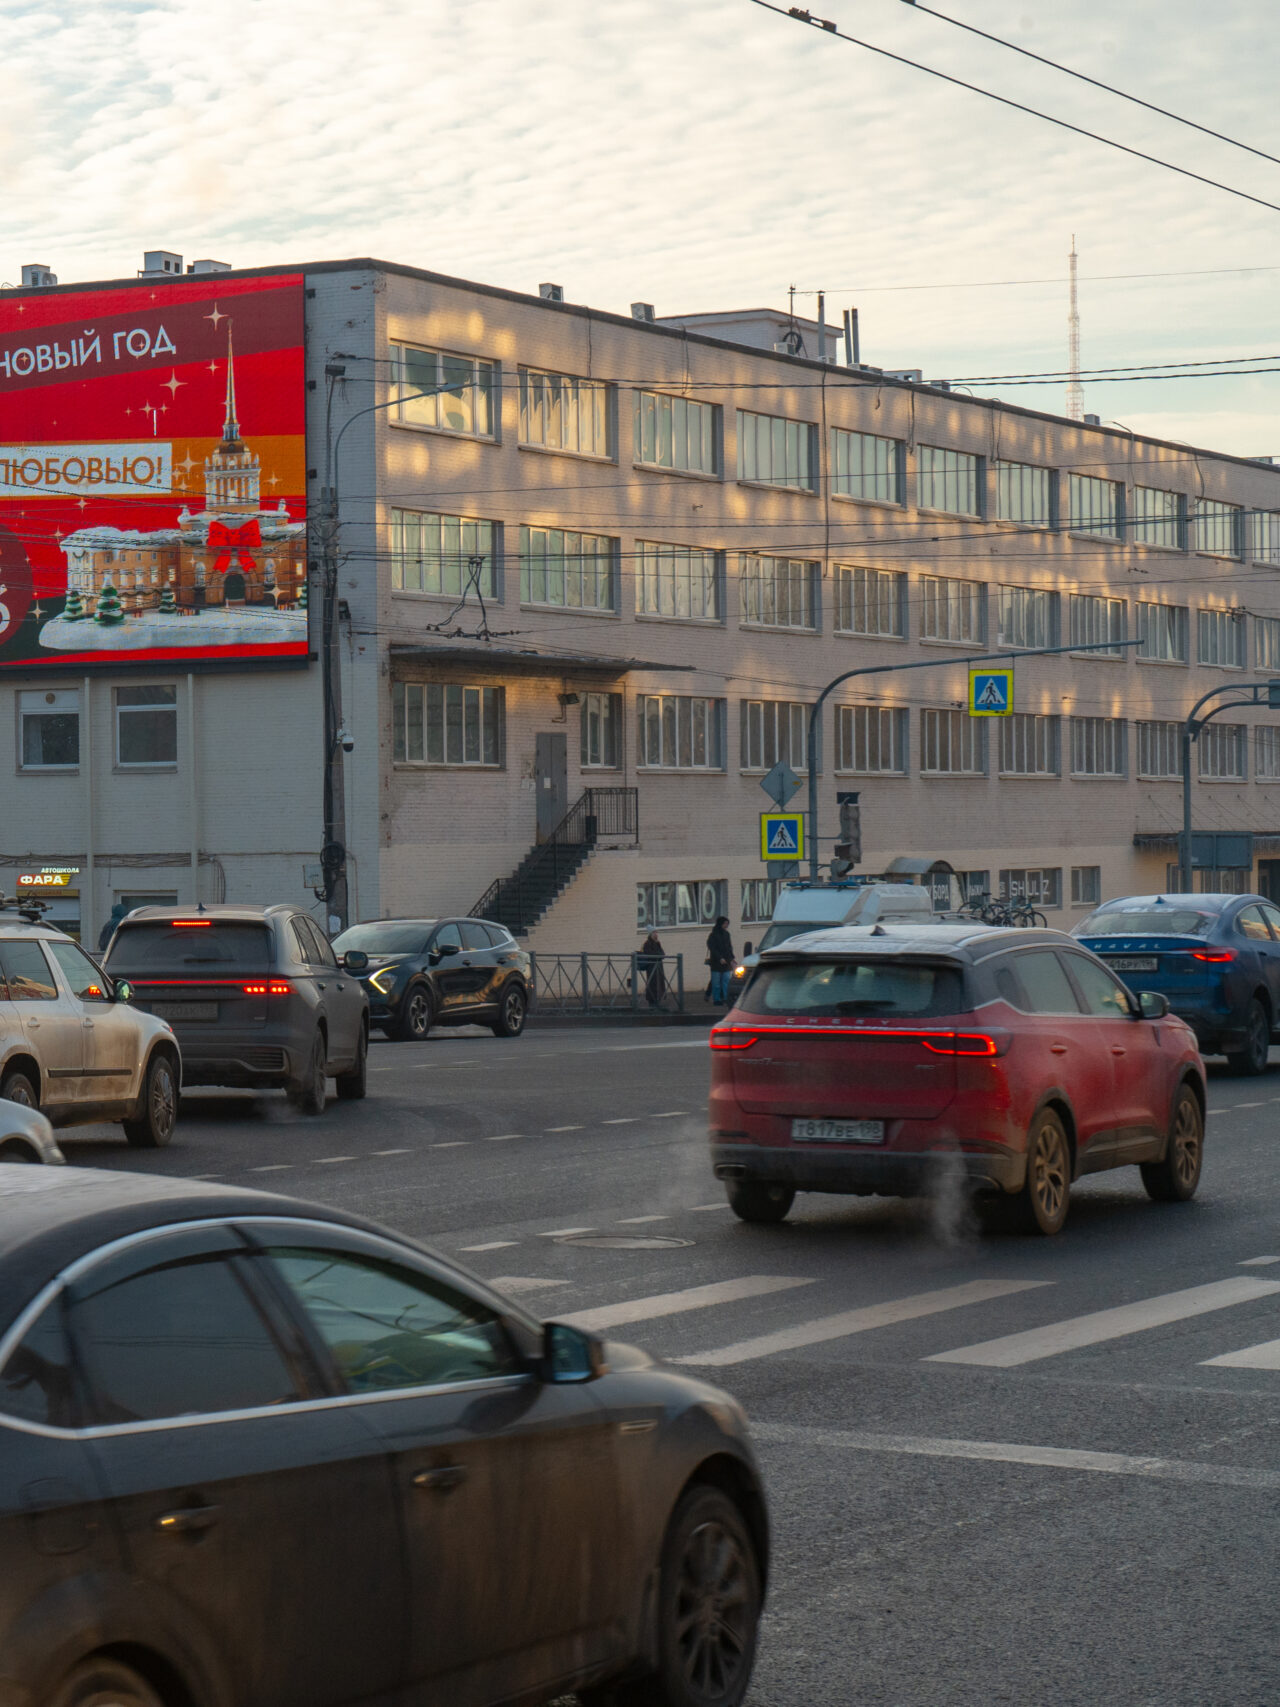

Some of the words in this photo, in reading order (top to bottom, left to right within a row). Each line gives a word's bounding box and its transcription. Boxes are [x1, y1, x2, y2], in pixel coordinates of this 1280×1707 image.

[112, 324, 177, 360] ГОД
[19, 875, 64, 885] ФАРА
[786, 1018, 890, 1026] CHERY
